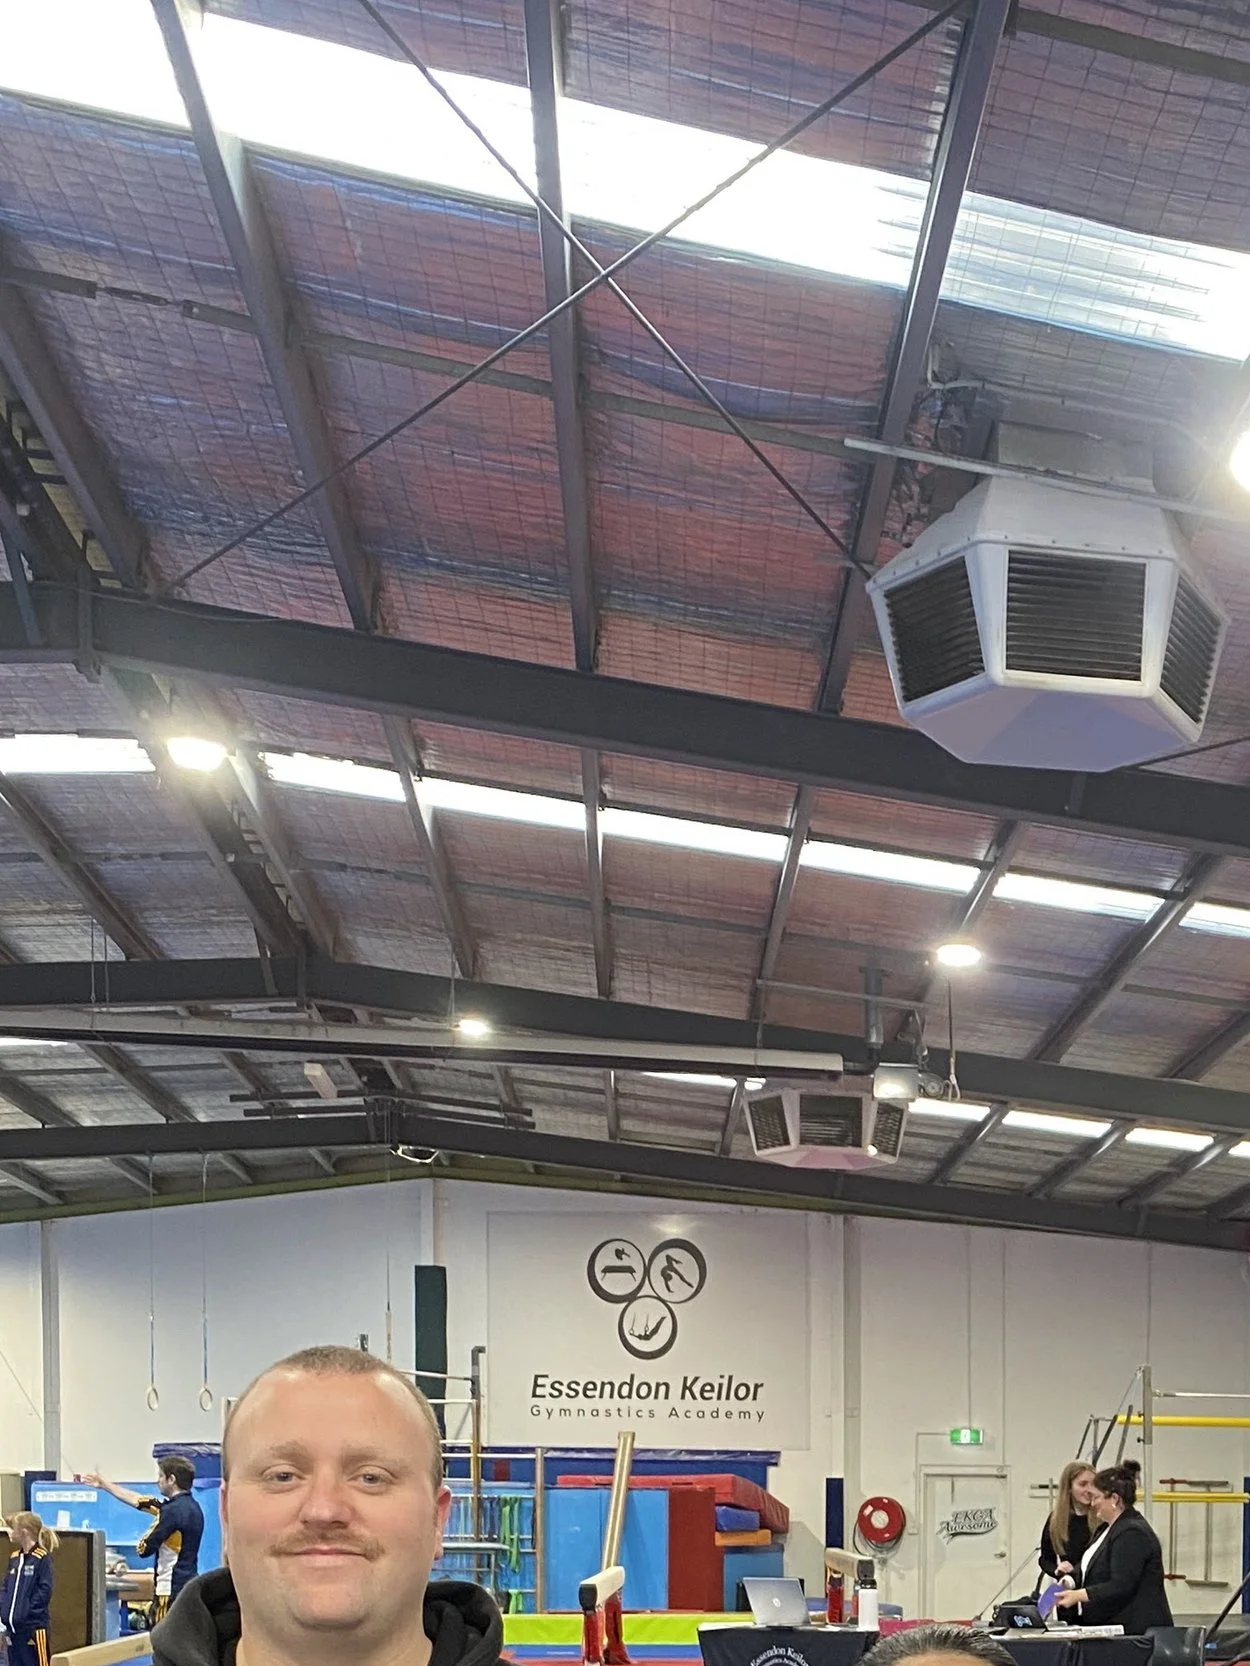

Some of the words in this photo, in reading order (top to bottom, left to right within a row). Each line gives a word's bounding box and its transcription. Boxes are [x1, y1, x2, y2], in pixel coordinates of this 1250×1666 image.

[531, 1373, 670, 1400] Essendon
[680, 1374, 764, 1401] Keilor
[530, 1405, 656, 1419] Gymnastics
[668, 1407, 765, 1422] Academy
